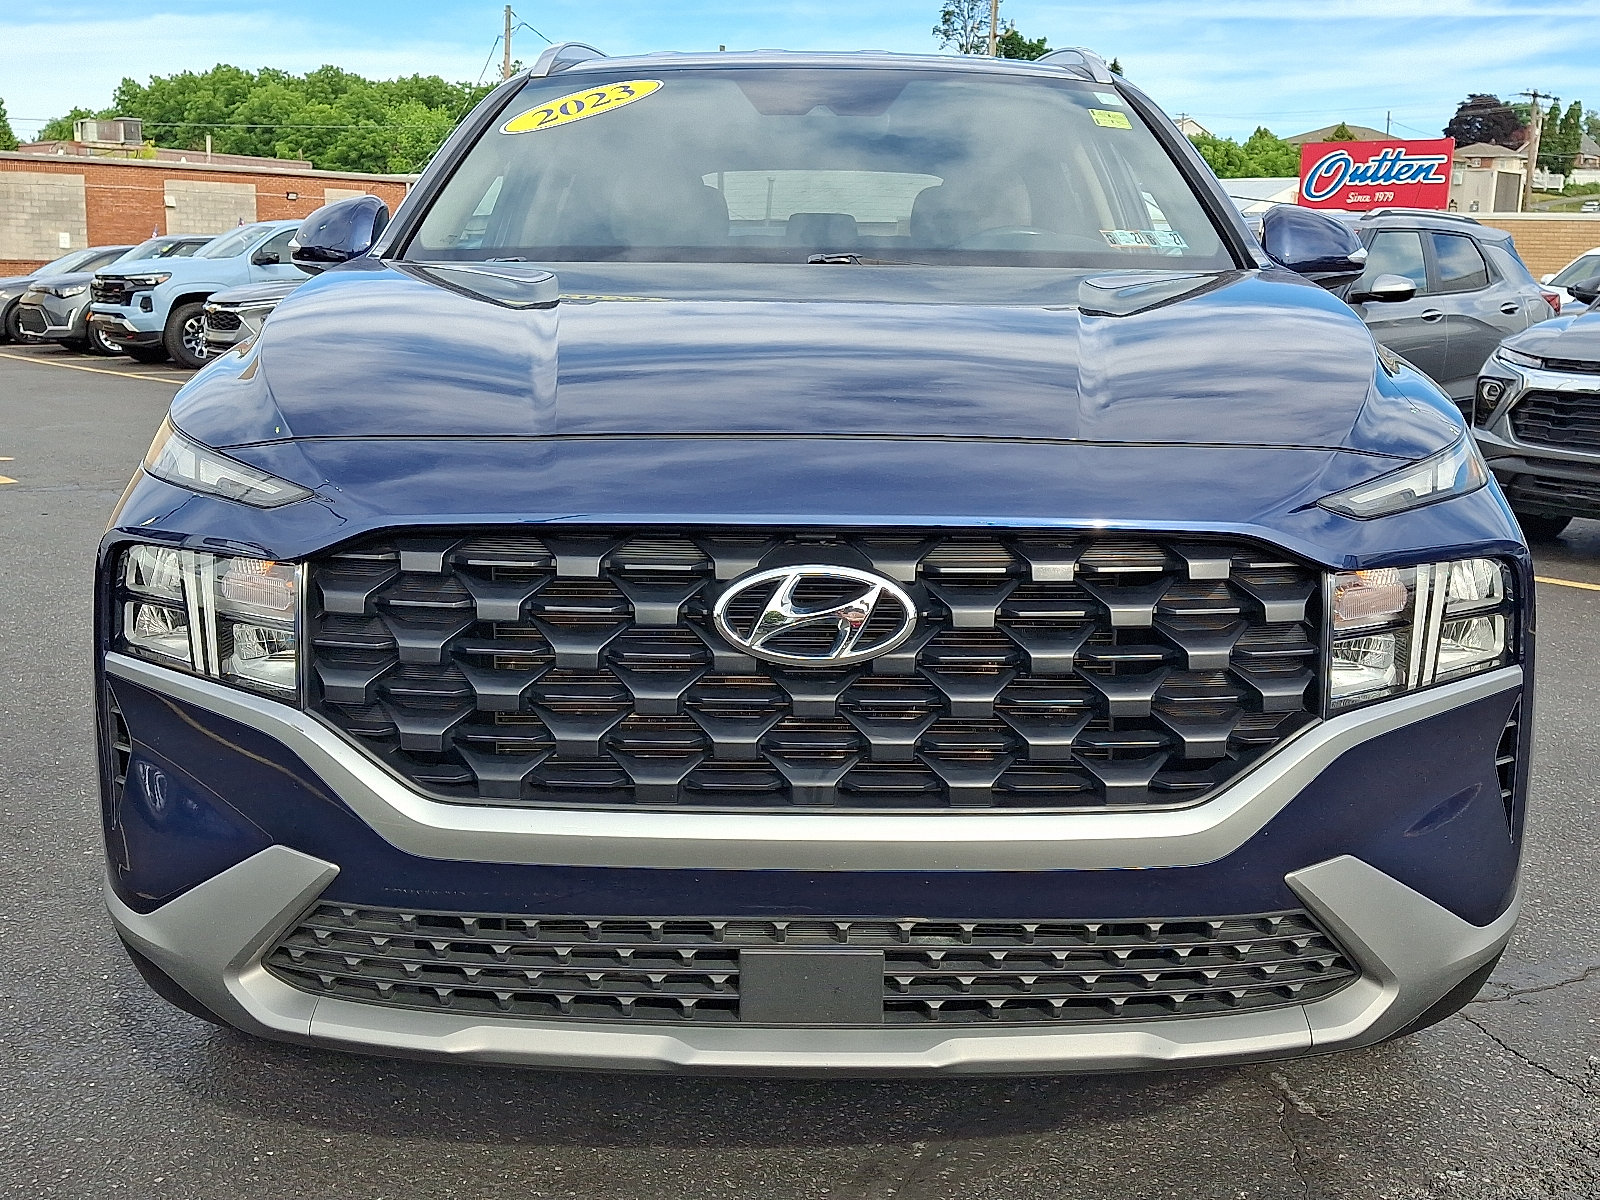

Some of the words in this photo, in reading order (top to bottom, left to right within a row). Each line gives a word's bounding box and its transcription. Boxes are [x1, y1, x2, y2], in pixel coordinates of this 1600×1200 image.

[531, 85, 635, 127] 2023
[1303, 148, 1447, 201] Outten
[1346, 191, 1371, 204] Since
[1374, 191, 1394, 202] 1979
